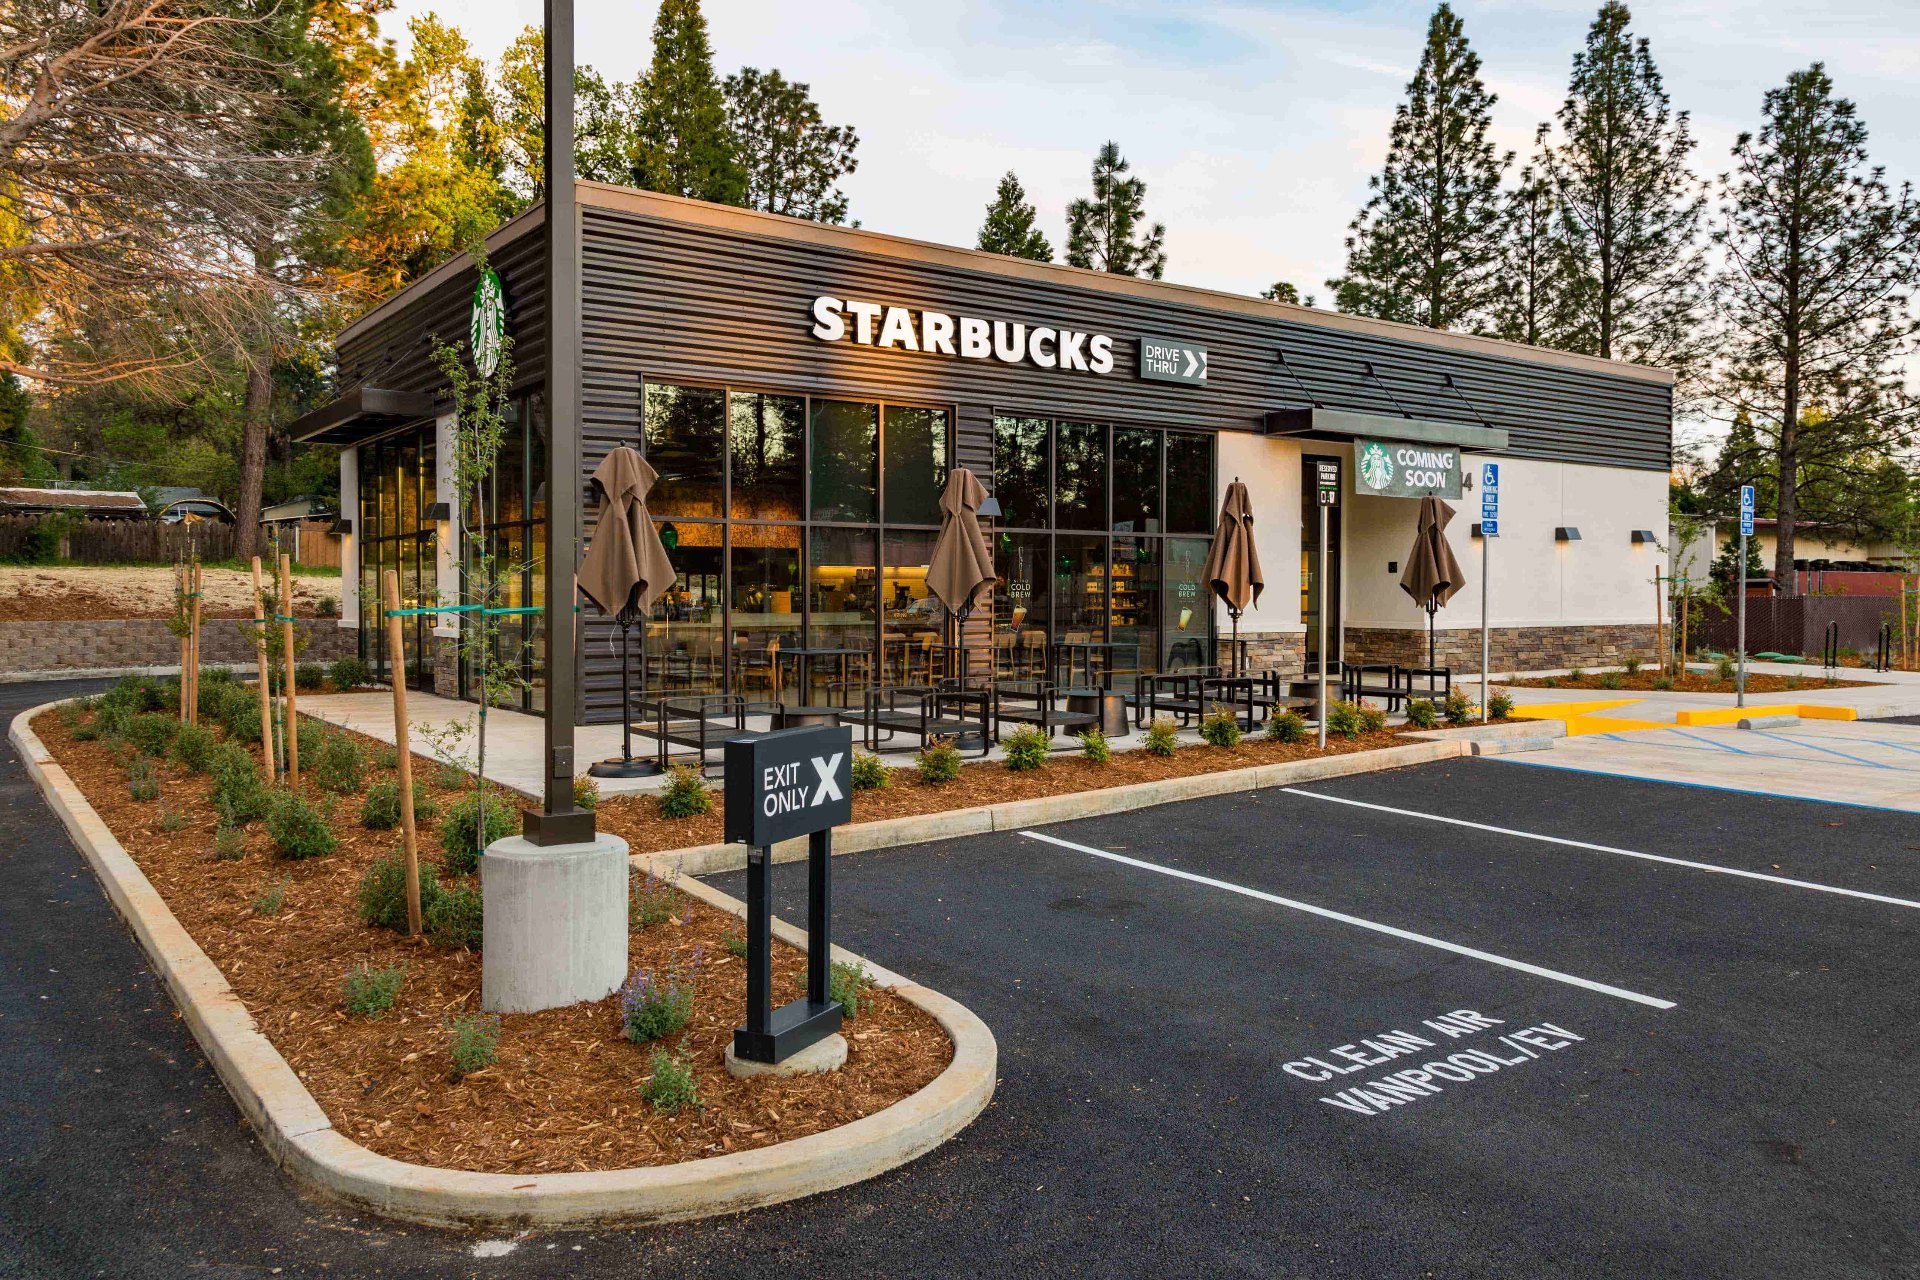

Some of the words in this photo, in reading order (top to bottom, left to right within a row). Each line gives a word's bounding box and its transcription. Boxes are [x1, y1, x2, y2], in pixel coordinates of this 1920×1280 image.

[812, 296, 1114, 374] STARBUCKS
[1145, 345, 1180, 362] DRIVE
[1146, 359, 1177, 375] THRU
[1396, 449, 1453, 469] COMING
[1405, 469, 1446, 488] SOON
[1460, 472, 1473, 491] 4
[1011, 583, 1031, 591] COLD
[1179, 583, 1196, 591] COLD
[764, 762, 801, 791] EXIT
[763, 785, 809, 817] ONLY
[1282, 1030, 1436, 1081] CLEAN
[1422, 1009, 1505, 1038] AIR
[1319, 1022, 1585, 1115] VANPOOL/EV
